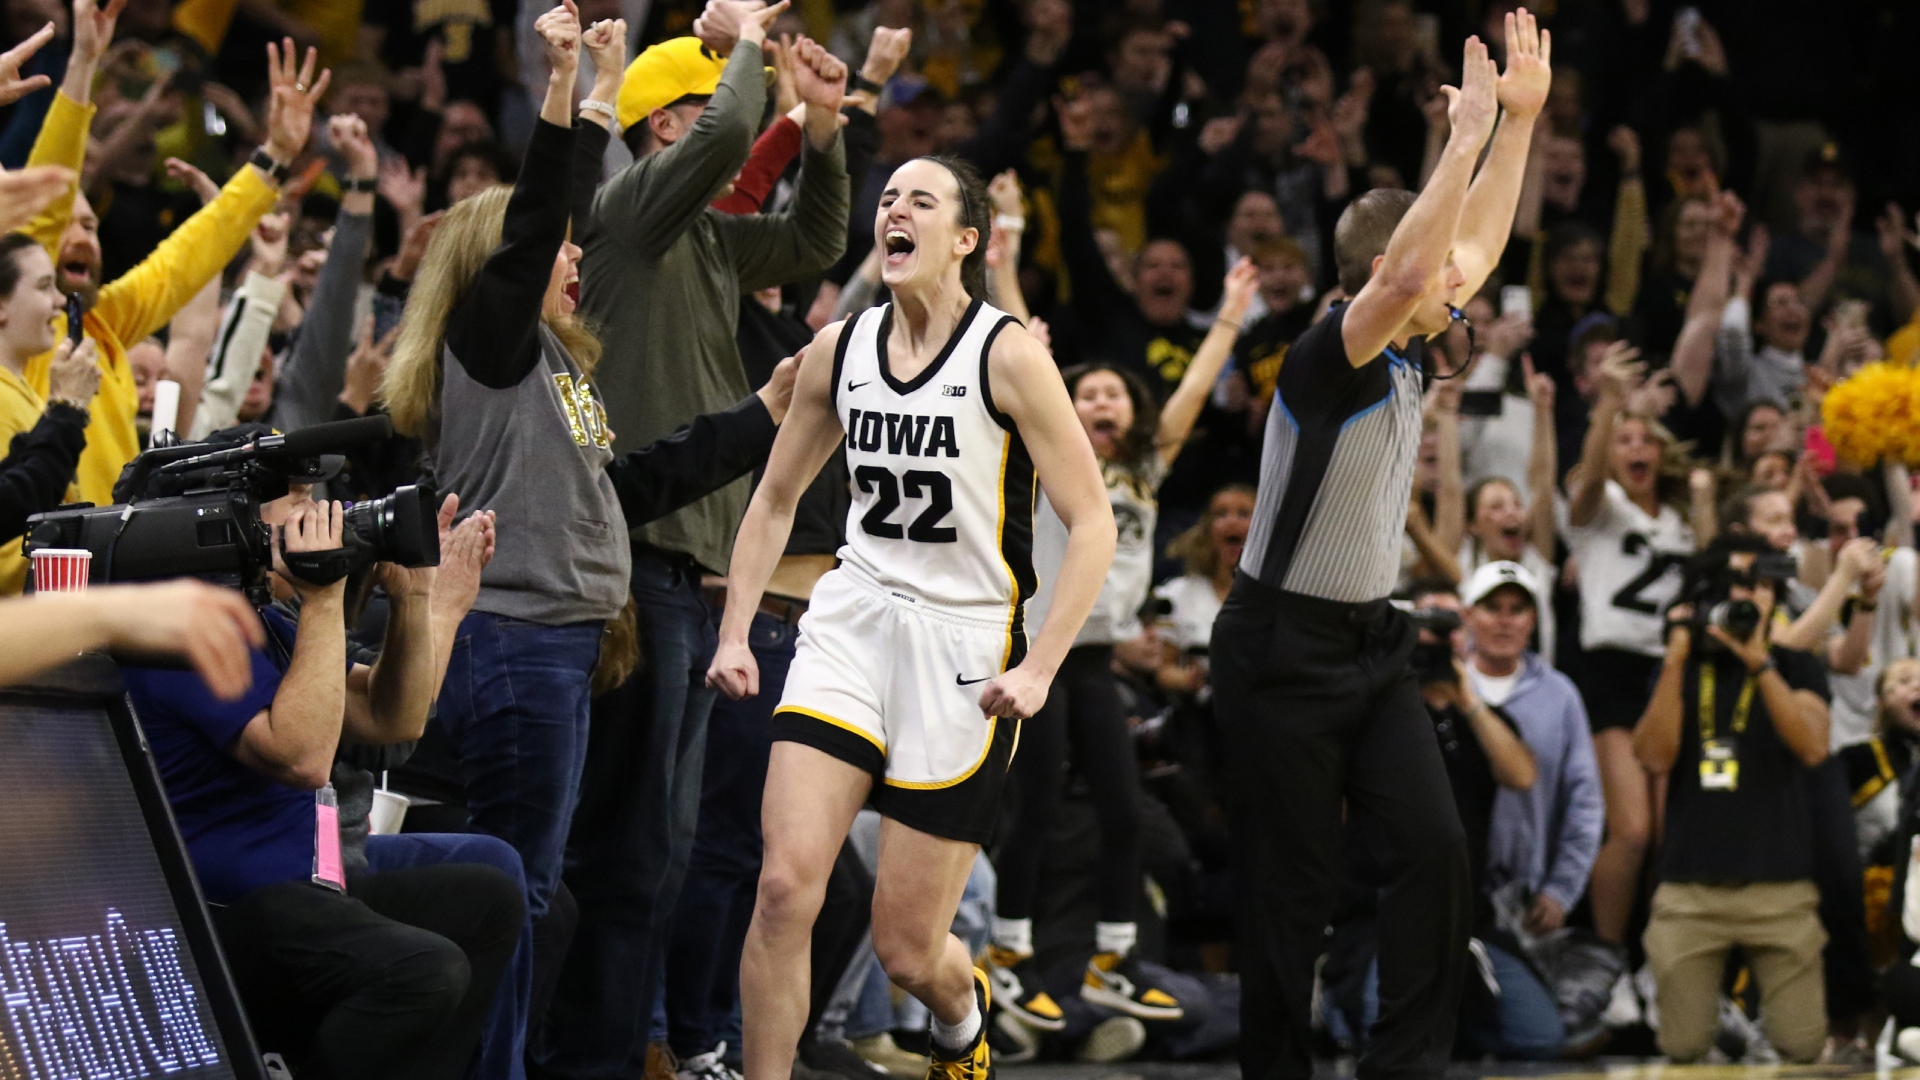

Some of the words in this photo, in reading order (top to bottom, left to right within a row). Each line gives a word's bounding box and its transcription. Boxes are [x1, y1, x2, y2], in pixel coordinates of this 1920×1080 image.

[848, 407, 960, 458] IOWA
[197, 507, 225, 516] SONY
[854, 464, 958, 543] 22
